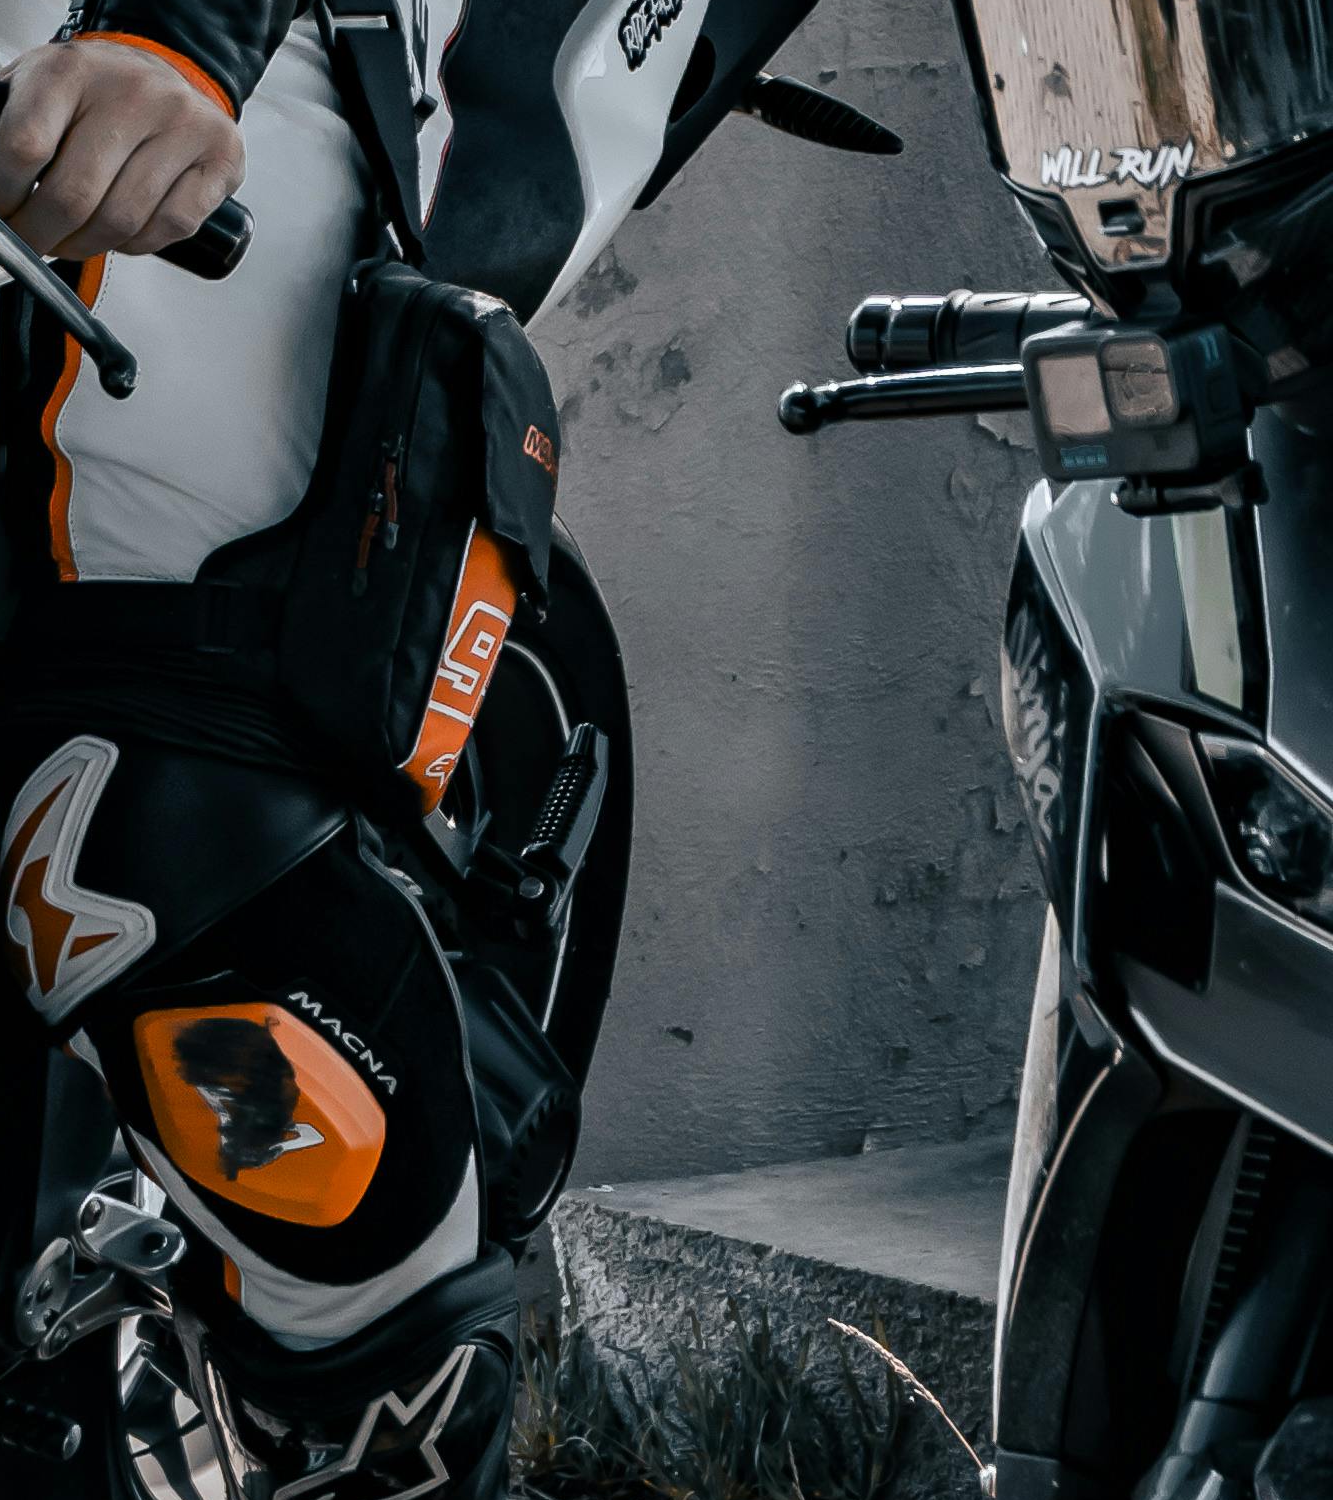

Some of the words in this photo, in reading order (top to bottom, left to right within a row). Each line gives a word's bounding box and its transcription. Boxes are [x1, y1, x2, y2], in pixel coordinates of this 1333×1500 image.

[1040, 145, 1108, 187] WILL
[1110, 138, 1195, 189] RUN
[288, 991, 398, 1096] MACNA
